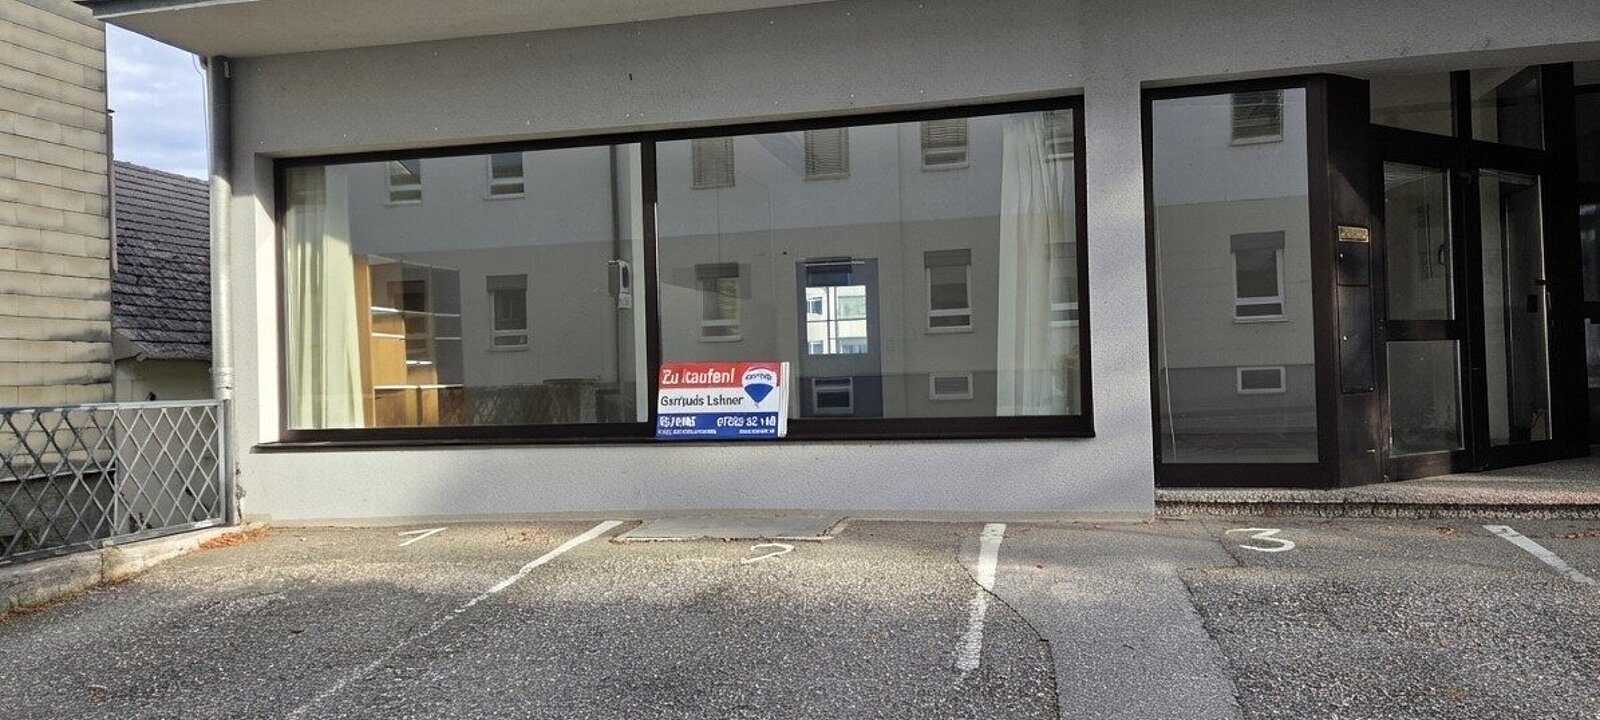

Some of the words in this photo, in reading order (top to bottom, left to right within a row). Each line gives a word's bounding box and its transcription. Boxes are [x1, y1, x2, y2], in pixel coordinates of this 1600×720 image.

[661, 368, 680, 385] Zu
[398, 526, 448, 547] 1
[1225, 527, 1296, 552] 3
[741, 543, 795, 564] 2
